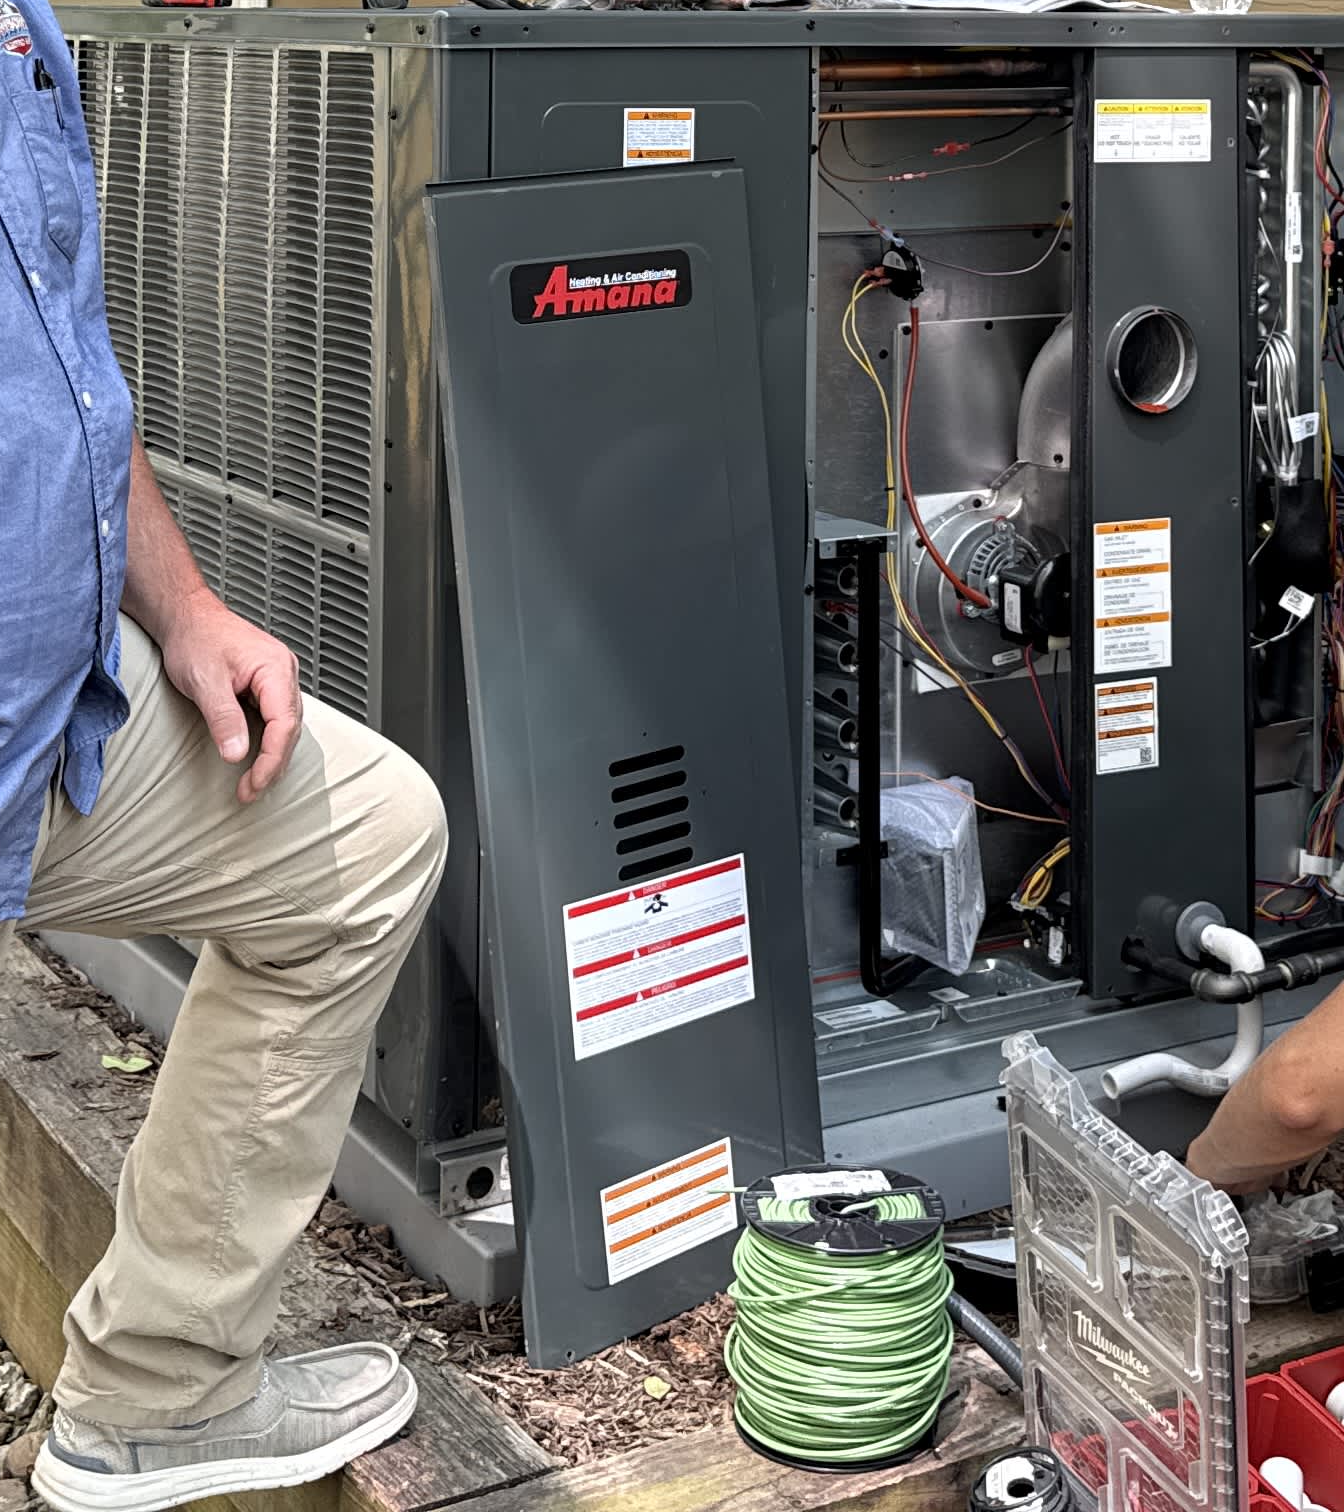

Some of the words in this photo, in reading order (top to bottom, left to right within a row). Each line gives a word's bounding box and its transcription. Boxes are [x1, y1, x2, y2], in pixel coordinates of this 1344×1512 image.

[532, 265, 678, 318] Amana
[570, 276, 601, 288] Heating
[611, 272, 625, 283] Air
[625, 267, 677, 281] Conditioning
[1072, 1310, 1152, 1378] Milwaukee
[1113, 1372, 1179, 1439] PACKOUT
